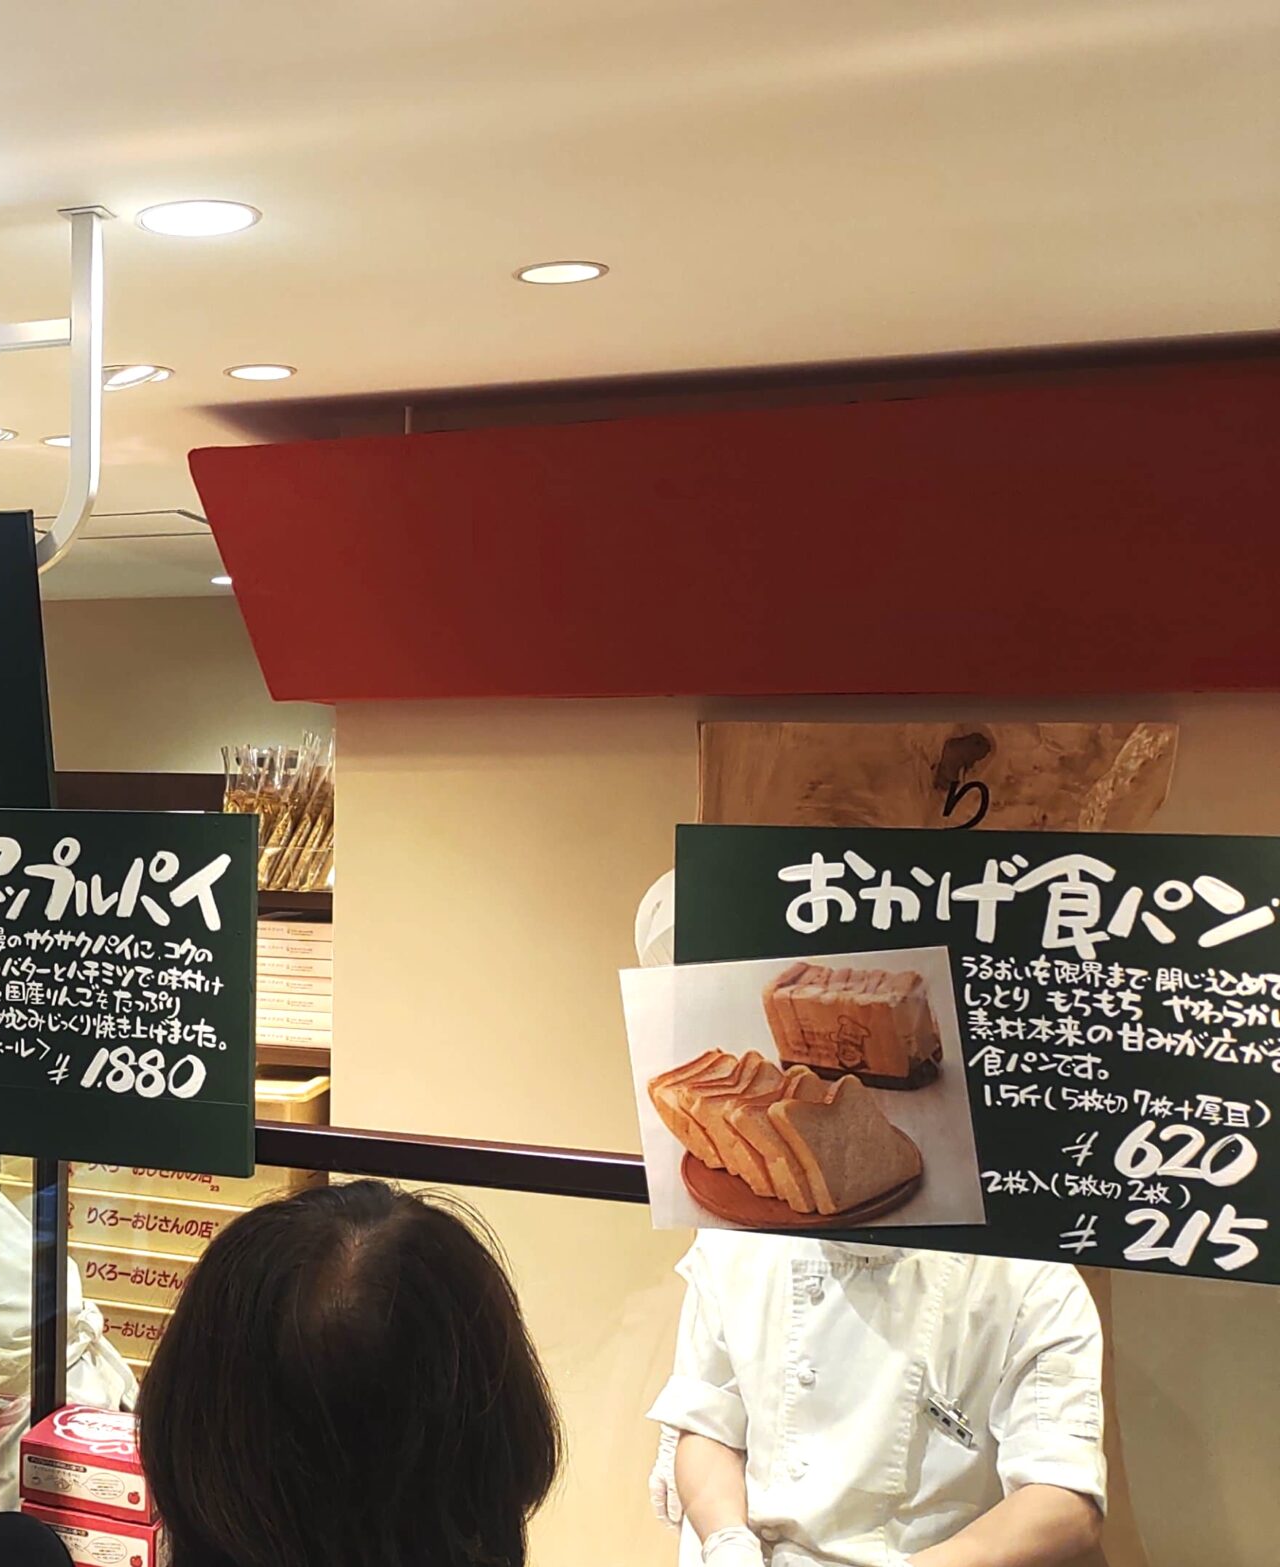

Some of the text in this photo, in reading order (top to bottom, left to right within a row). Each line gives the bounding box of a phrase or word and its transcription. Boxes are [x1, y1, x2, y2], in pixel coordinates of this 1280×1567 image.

[777, 849, 1276, 960] おかげ食パン
[968, 1046, 1109, 1081] 食パンです。
